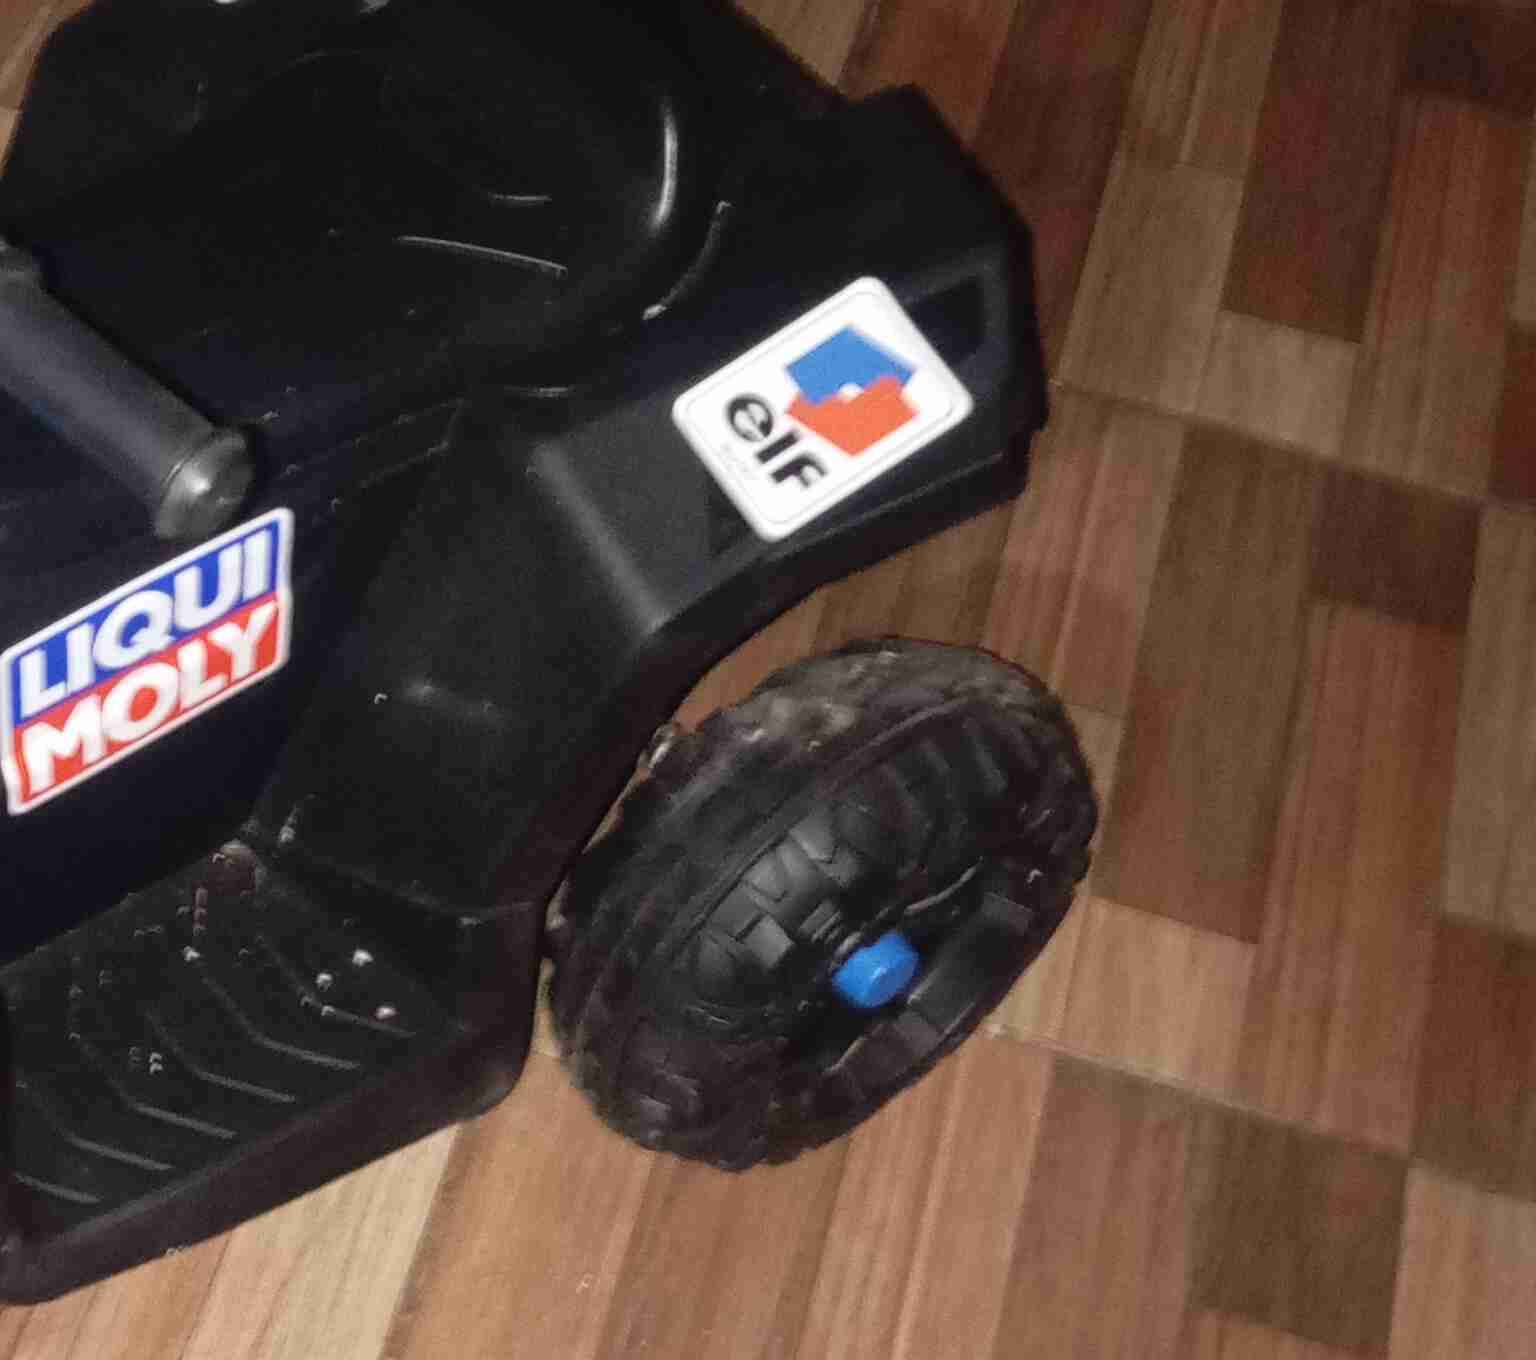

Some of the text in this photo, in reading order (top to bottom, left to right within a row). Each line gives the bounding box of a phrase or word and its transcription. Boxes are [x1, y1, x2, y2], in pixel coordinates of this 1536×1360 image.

[726, 393, 826, 487] elf
[20, 528, 274, 720] LIQUI
[21, 600, 278, 793] MOLY
